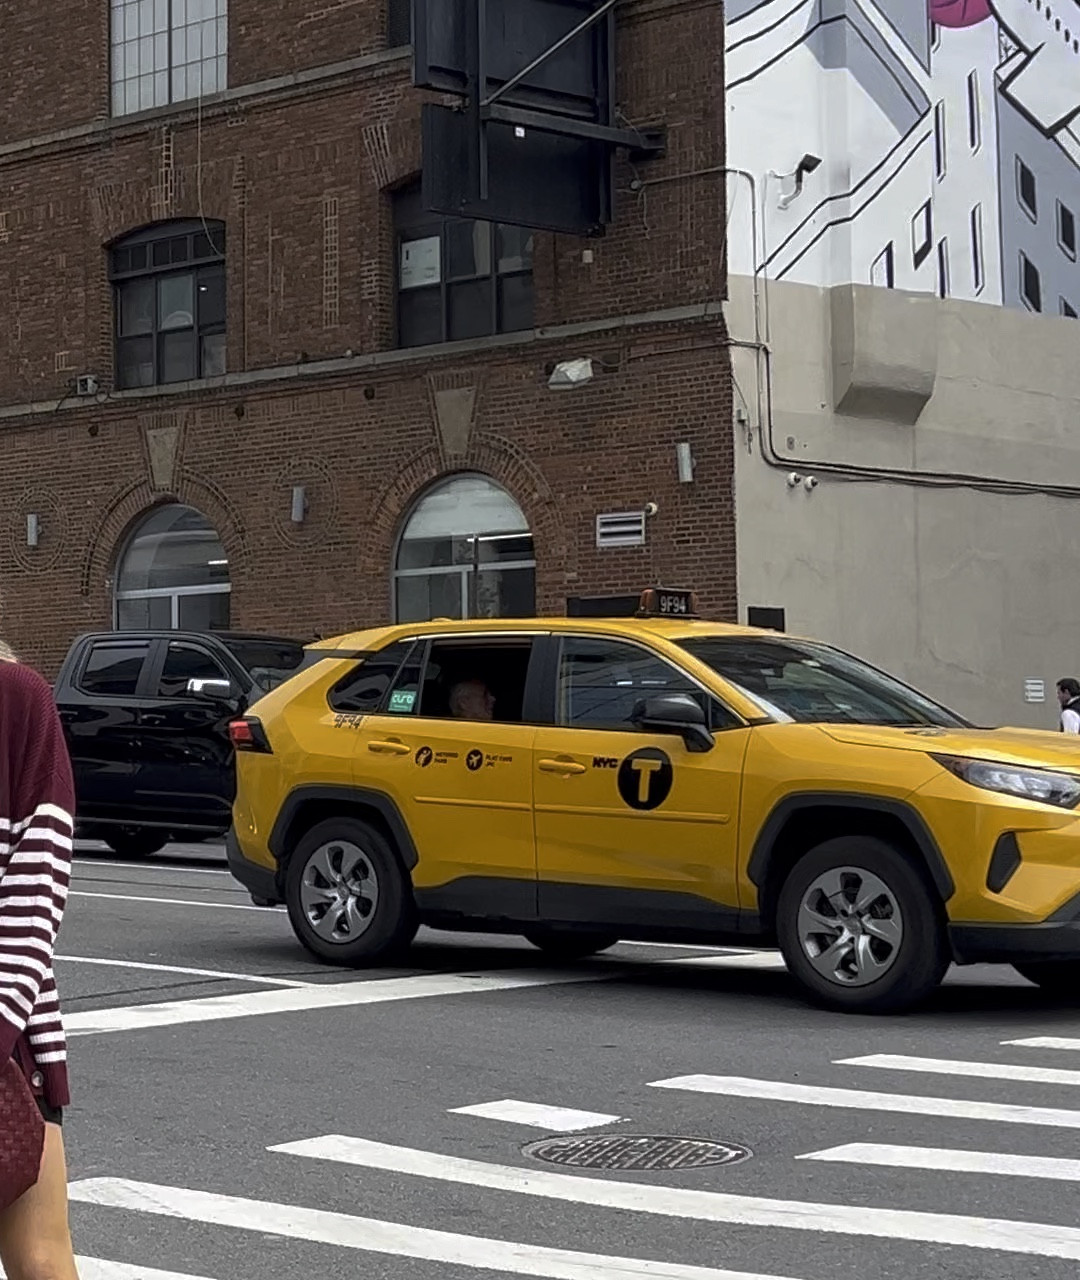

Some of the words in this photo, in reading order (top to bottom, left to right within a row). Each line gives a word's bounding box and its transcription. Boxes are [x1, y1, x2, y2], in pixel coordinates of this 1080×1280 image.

[660, 595, 686, 613] 9F94
[592, 757, 618, 768] NYC
[631, 758, 662, 803] T
